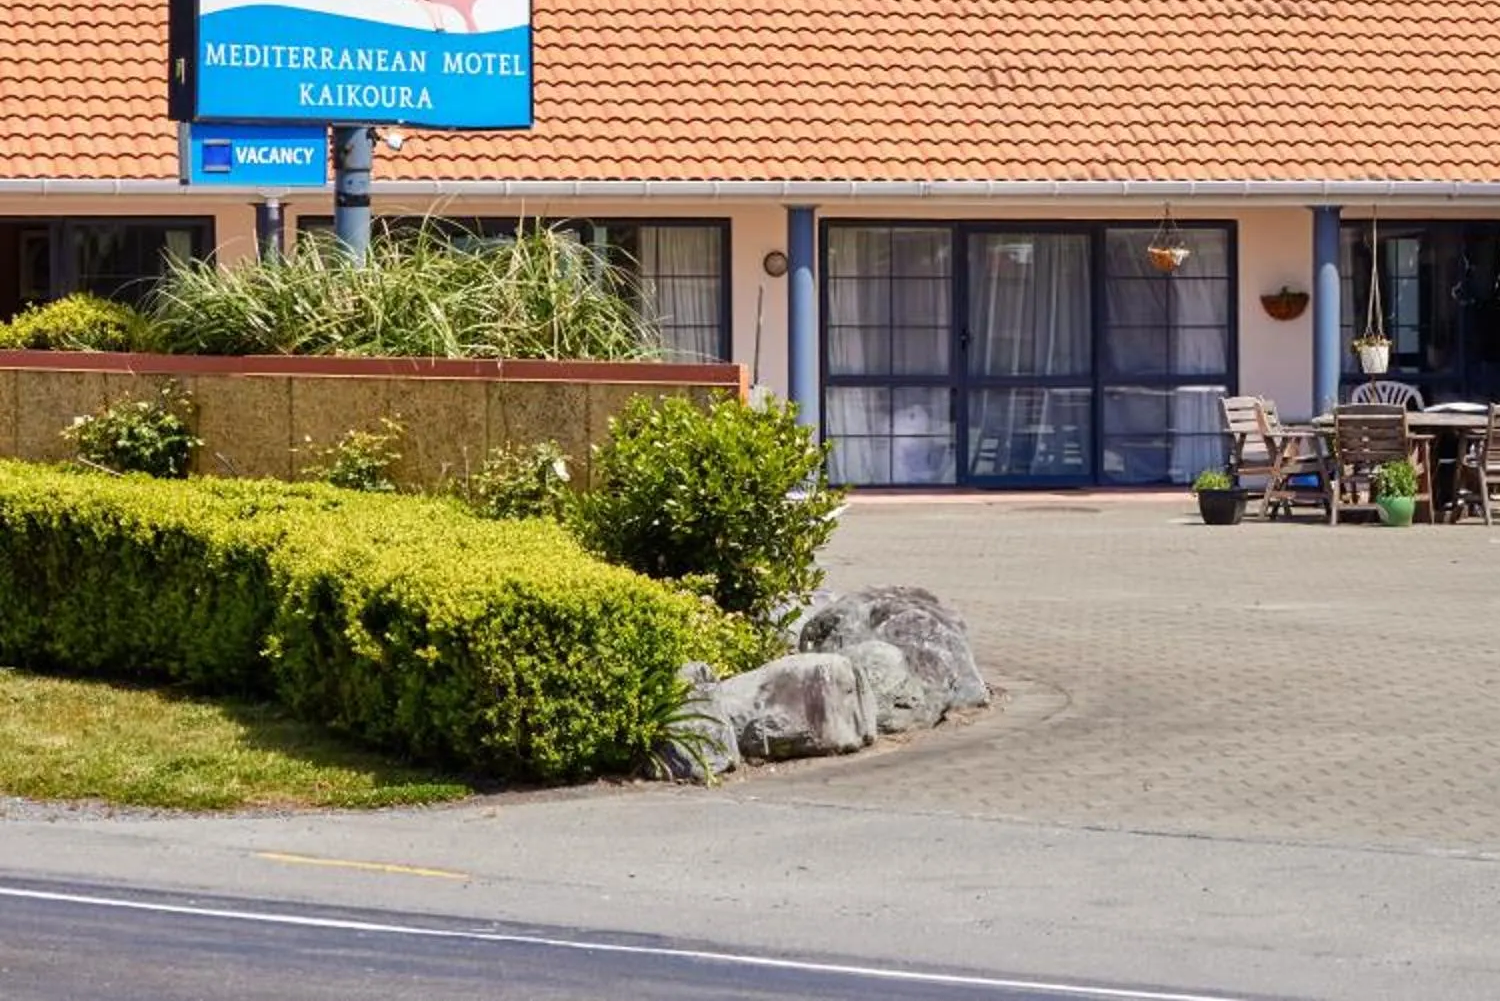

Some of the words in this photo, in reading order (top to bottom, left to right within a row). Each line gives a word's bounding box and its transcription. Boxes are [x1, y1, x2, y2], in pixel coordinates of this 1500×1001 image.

[205, 43, 426, 73] MEDITERRANEAN
[442, 52, 526, 76] MOTEL
[300, 83, 432, 109] KAIKOURA
[236, 146, 314, 165] VACANCY
